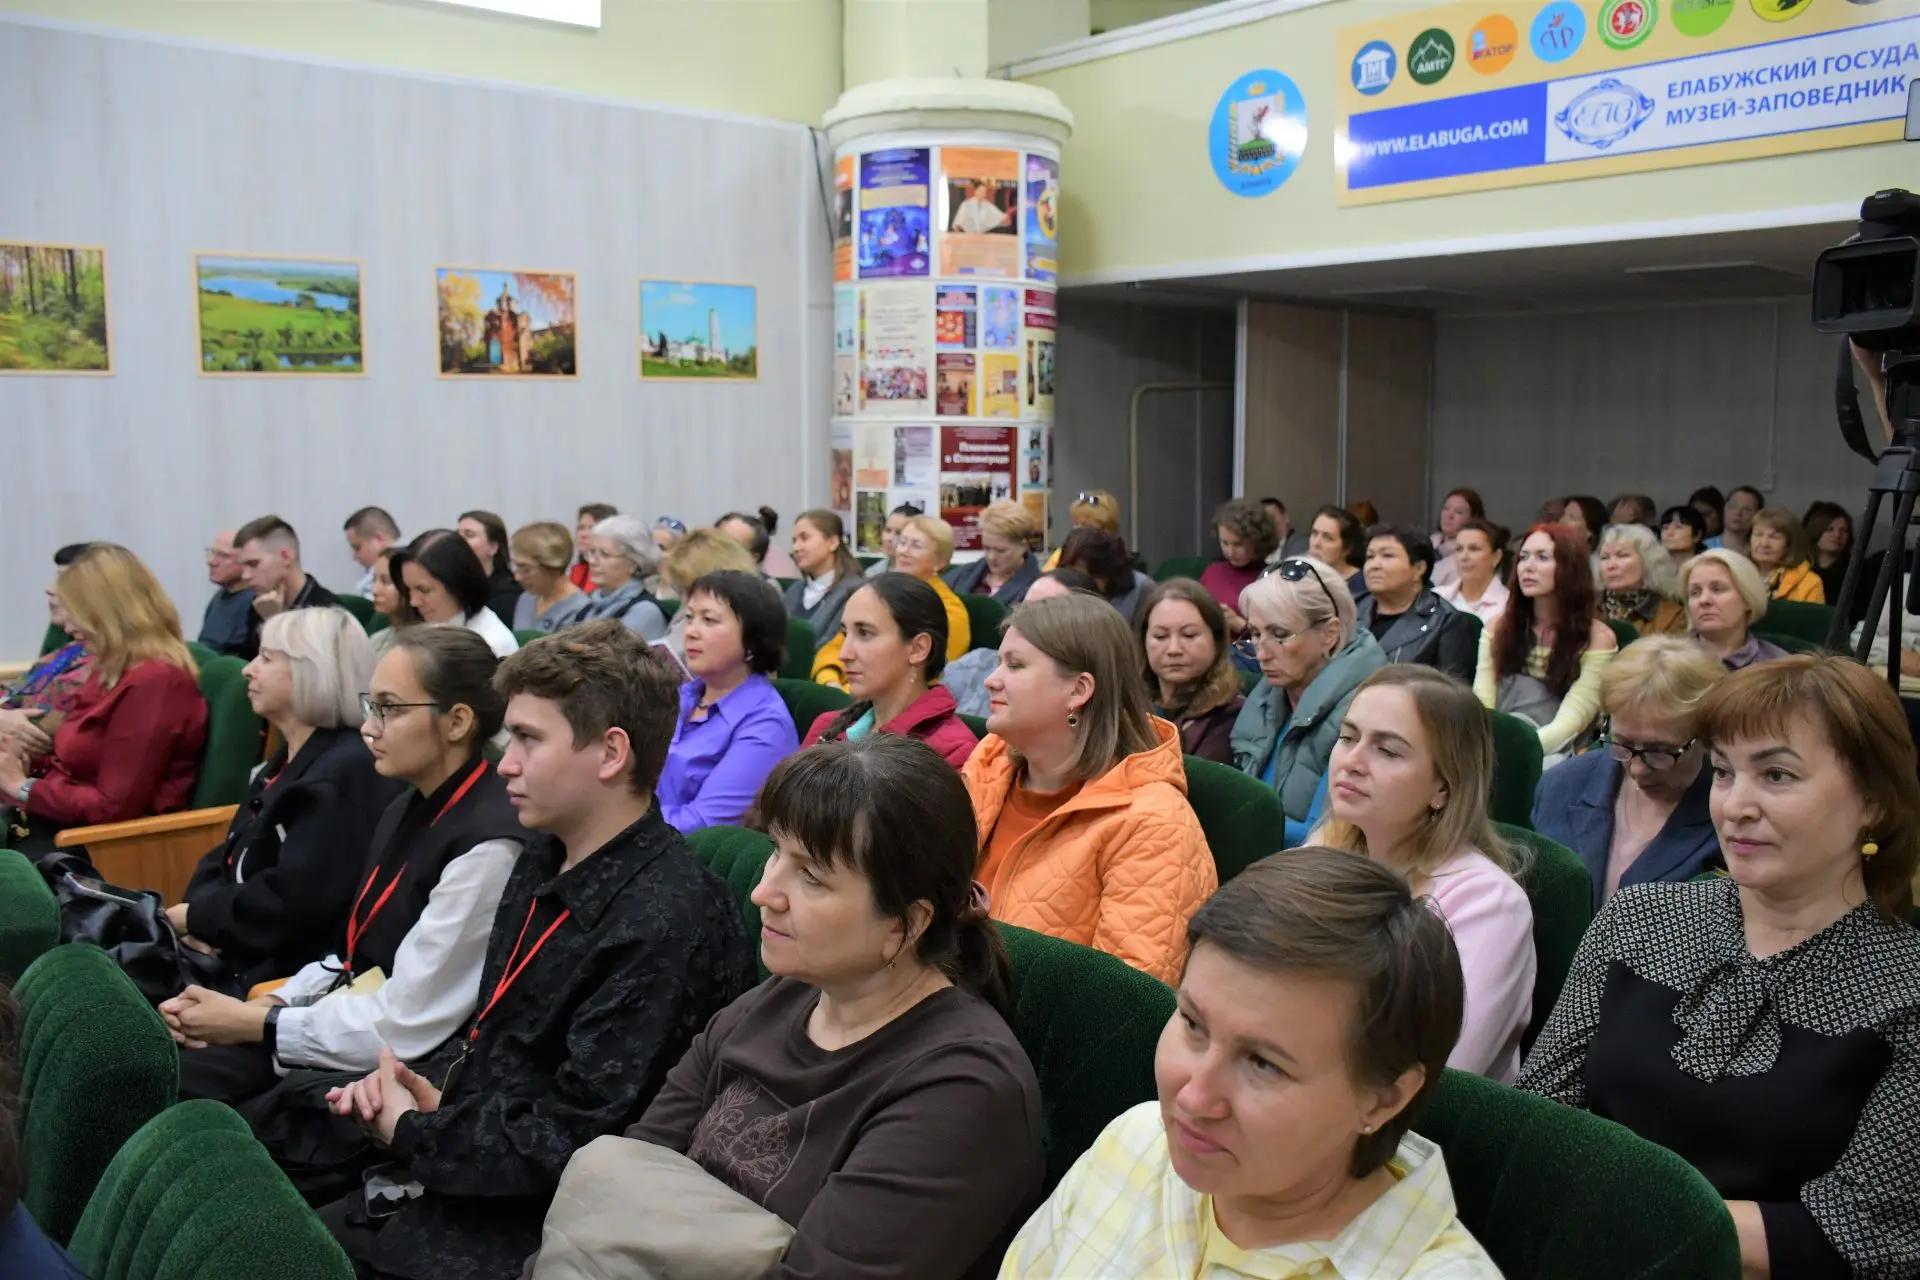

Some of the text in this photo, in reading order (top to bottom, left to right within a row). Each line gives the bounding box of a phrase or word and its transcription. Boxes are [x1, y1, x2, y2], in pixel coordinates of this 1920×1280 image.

[1667, 42, 1919, 99] ЕЛАБУЖСКИЙ ГОСУДА
[1666, 74, 1906, 126] МУЗЕЙ-ЗАПОВЕДНИК
[1363, 118, 1529, 158] WWW.ELABUGA.COM
